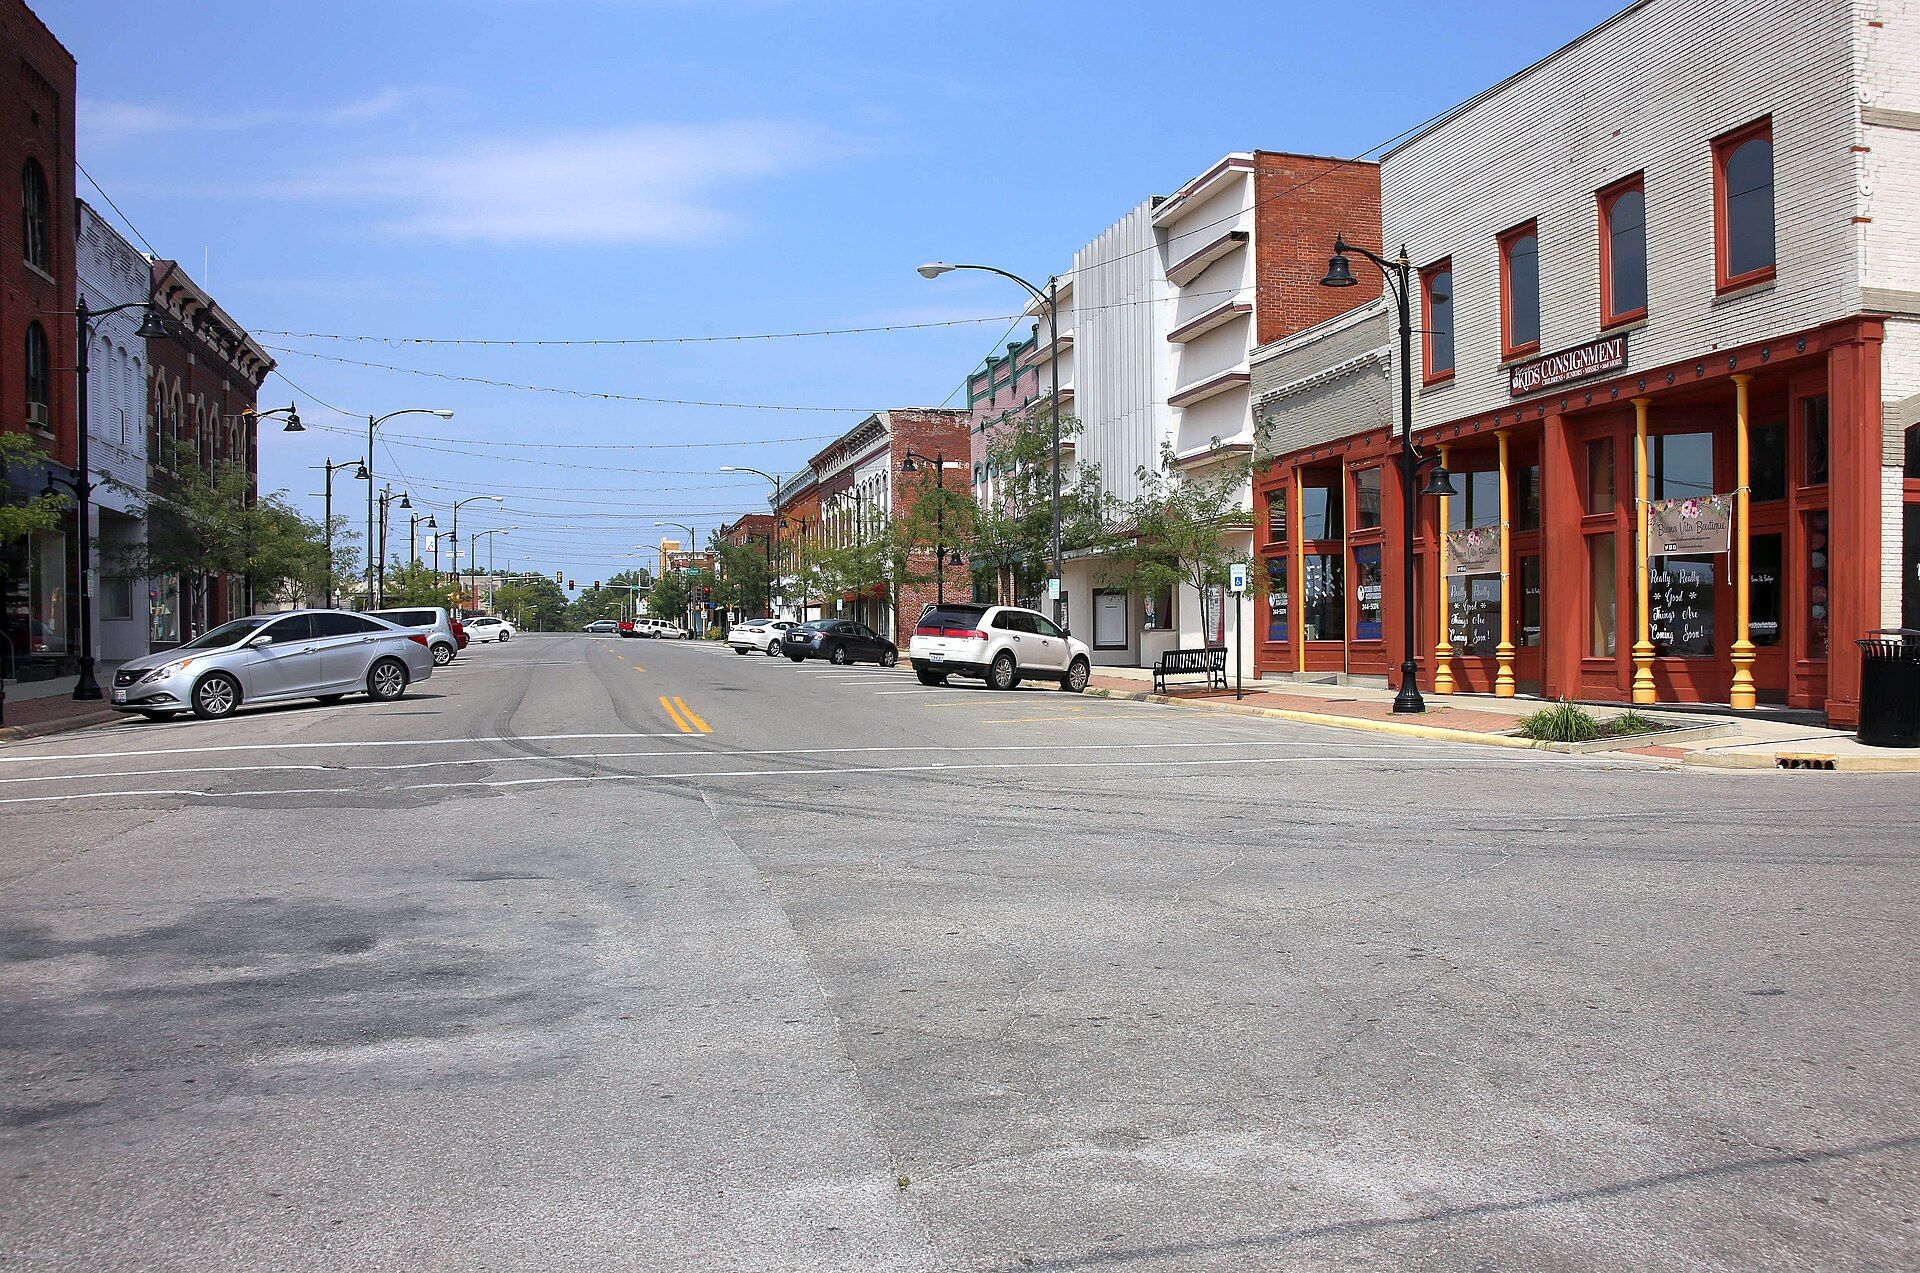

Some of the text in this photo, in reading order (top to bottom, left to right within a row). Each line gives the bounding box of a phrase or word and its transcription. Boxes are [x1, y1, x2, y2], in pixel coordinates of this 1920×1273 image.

[1517, 338, 1623, 391] KIDS CONSIGNMENT
[1609, 358, 1623, 367] MORE
[1679, 521, 1694, 535] Vita
[1696, 519, 1726, 534] Boutique
[1650, 568, 1700, 587] Really Really
[1664, 587, 1684, 607] Good
[1462, 598, 1477, 615] Good
[1652, 605, 1699, 623] Things Are
[1450, 612, 1485, 628] Things Are
[1448, 627, 1490, 646] Coming Soon!
[1649, 623, 1704, 645] Coming Soon!
